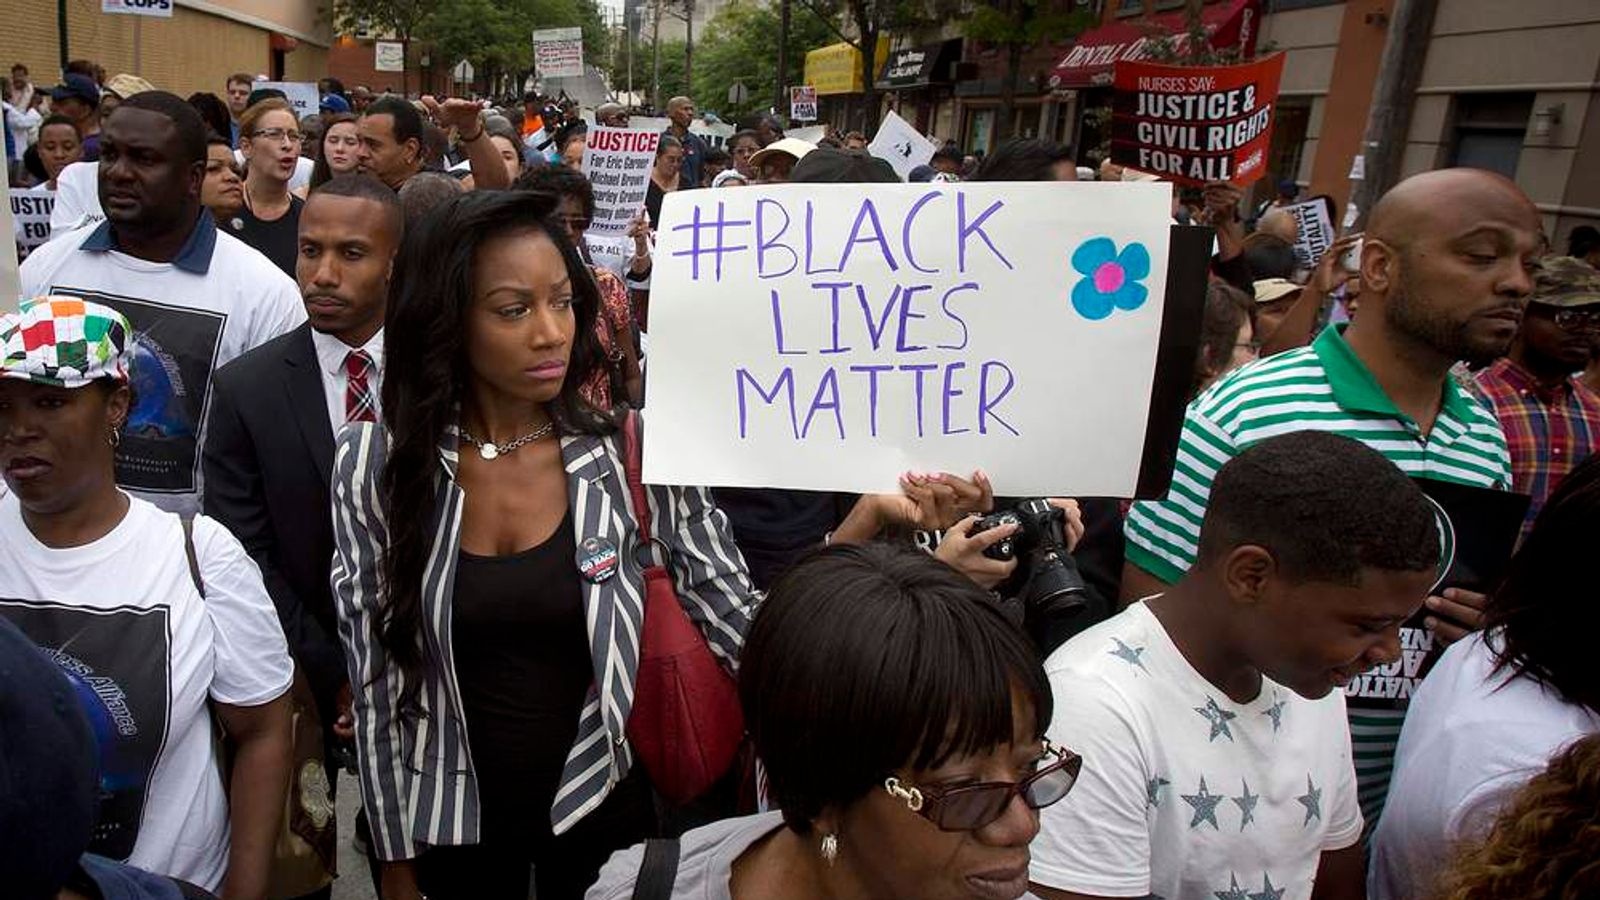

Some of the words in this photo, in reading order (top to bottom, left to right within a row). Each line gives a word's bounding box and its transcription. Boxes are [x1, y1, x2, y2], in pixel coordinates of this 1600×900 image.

[1057, 43, 1125, 68] DENTAL
[1139, 77, 1186, 92] NURSES
[1188, 76, 1216, 92] SAY:
[1136, 90, 1240, 120] JUSTICE
[1243, 85, 1256, 112] &
[588, 130, 658, 152] JUSTICE
[1138, 122, 1200, 150] CIVIL
[1207, 104, 1271, 151] RIGHTS
[591, 154, 605, 168] For
[606, 155, 622, 169] Eric
[1139, 148, 1183, 175] FOR
[1189, 156, 1231, 181] ALL
[10, 196, 55, 215] USTI
[24, 222, 51, 238] FO
[672, 191, 1013, 282] #BLACK
[606, 246, 620, 256] ALL
[771, 282, 980, 355] LIVES
[736, 362, 1021, 440] MATTER
[82, 676, 137, 735] Alliance
